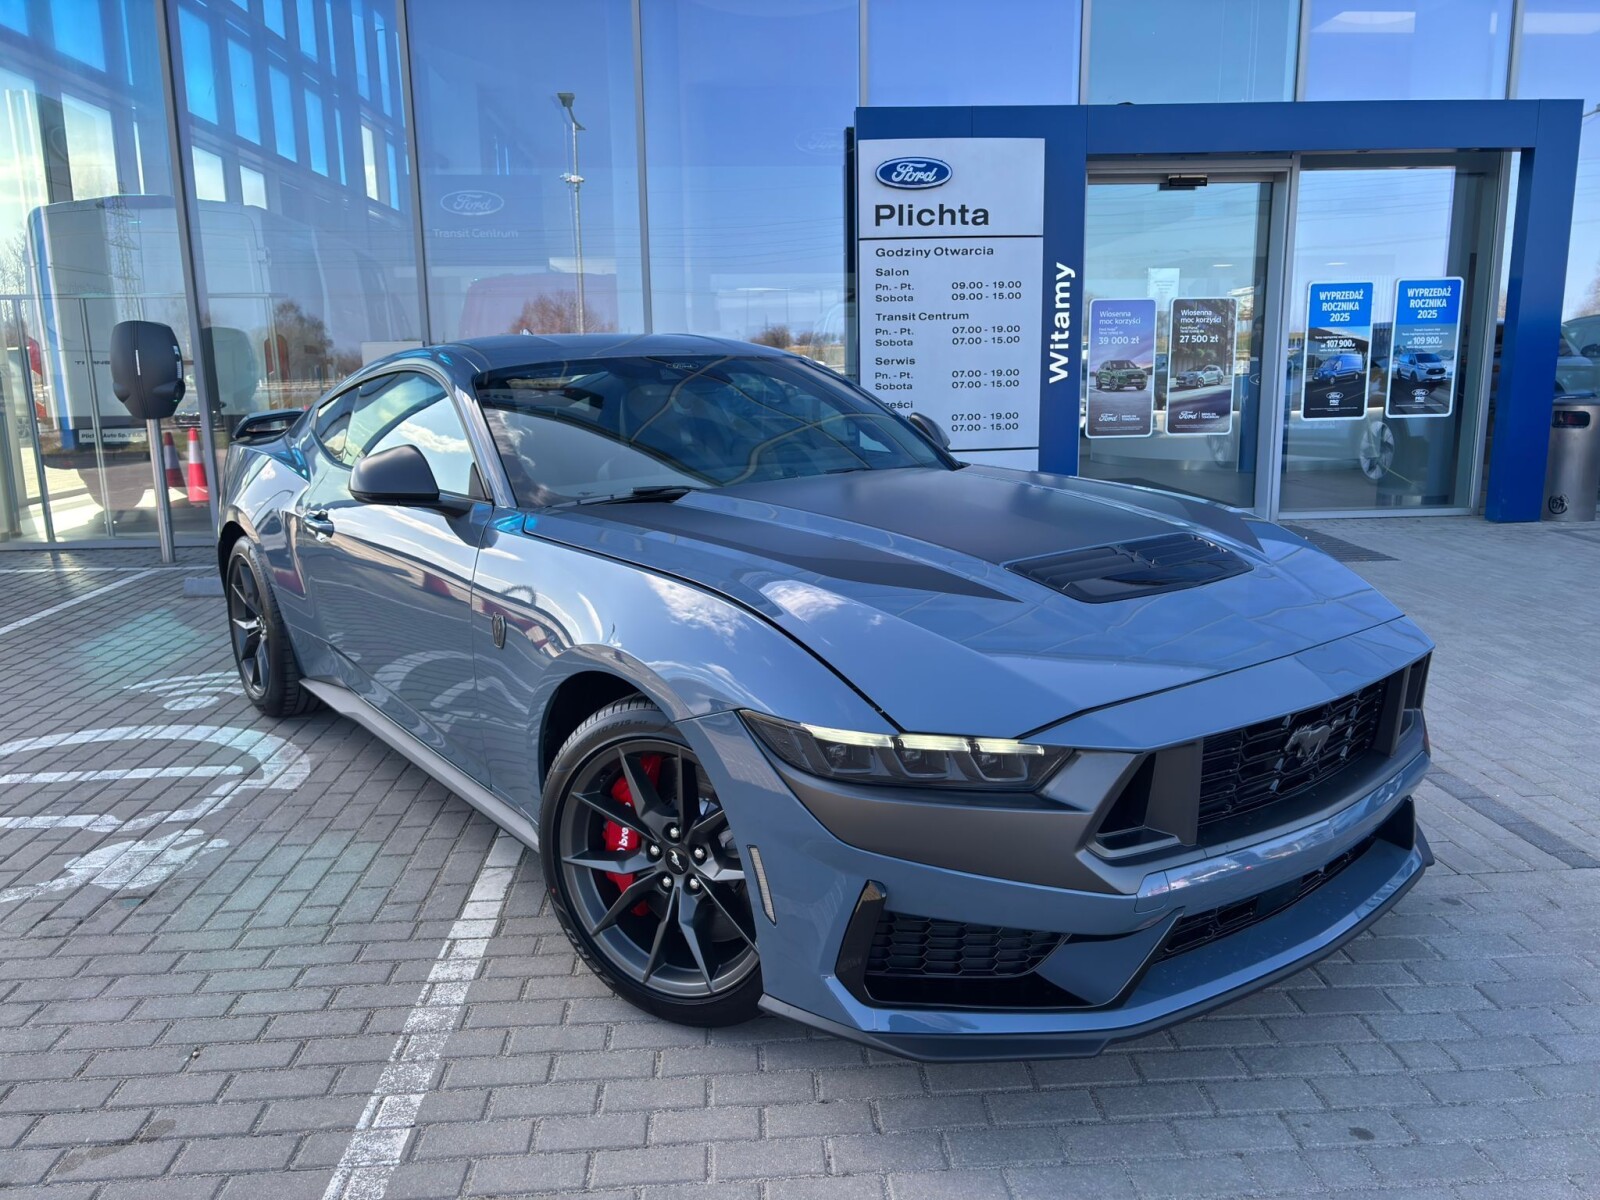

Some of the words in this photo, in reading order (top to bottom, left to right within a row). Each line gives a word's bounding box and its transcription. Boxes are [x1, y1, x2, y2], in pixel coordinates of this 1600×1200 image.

[891, 162, 938, 182] Ford
[453, 194, 492, 210] Ford
[875, 203, 990, 227] Plichta
[432, 228, 469, 238] Transit
[471, 228, 519, 238] Centrum
[875, 247, 932, 259] Godziny
[933, 246, 994, 257] Otwarcia
[875, 267, 910, 277] Salon
[875, 283, 892, 291] Pn.
[900, 282, 915, 291] Pt.
[951, 281, 984, 290] 09.00
[992, 280, 1022, 289] 19.00
[951, 292, 984, 301] 09.00
[992, 291, 1022, 300] 15.00
[1319, 289, 1364, 300] WYPRZEDAŻ
[1407, 286, 1452, 298] WYPRZEDAŻ
[875, 294, 914, 303] Sobota
[1322, 302, 1360, 311] ROCZNIKA
[1409, 299, 1447, 308] ROCZNIKA
[875, 312, 916, 322] Transit
[918, 312, 970, 321] Centrum
[1099, 310, 1131, 318] Wiosenna
[1330, 313, 1350, 322] 2025
[1417, 310, 1438, 319] 2025
[1048, 261, 1076, 384] Witamy
[1114, 317, 1141, 326] korzyści
[1195, 316, 1222, 325] korzyści
[875, 328, 892, 336] Pn.
[900, 327, 914, 336] Pt.
[951, 325, 983, 335] 07.00
[991, 324, 1021, 334] 19.00
[875, 338, 914, 347] Sobota
[951, 336, 983, 346] 07.00
[991, 335, 1021, 345] 15.00
[1098, 336, 1109, 345] 39
[1111, 336, 1129, 344] 000
[1130, 336, 1140, 344] zł
[1179, 335, 1190, 343] 27
[1191, 335, 1208, 343] 500
[1209, 334, 1219, 343] zł
[1413, 336, 1426, 345] 109
[1426, 336, 1440, 345] 900
[1326, 339, 1339, 348] 107
[1339, 339, 1353, 348] 900
[875, 356, 916, 366] Serwis
[875, 371, 891, 380] Pn.
[900, 371, 914, 379] Pt.
[951, 370, 982, 379] 07.00
[990, 368, 1020, 378] 19.00
[875, 382, 913, 391] Sobota
[951, 381, 982, 390] 07.00
[990, 379, 1020, 389] 15.00
[951, 413, 982, 422] 07.00
[990, 411, 1019, 420] 19.00
[1099, 413, 1118, 421] Ford
[1179, 411, 1198, 420] Ford
[951, 423, 982, 432] 07.00
[990, 422, 1019, 431] 15.00
